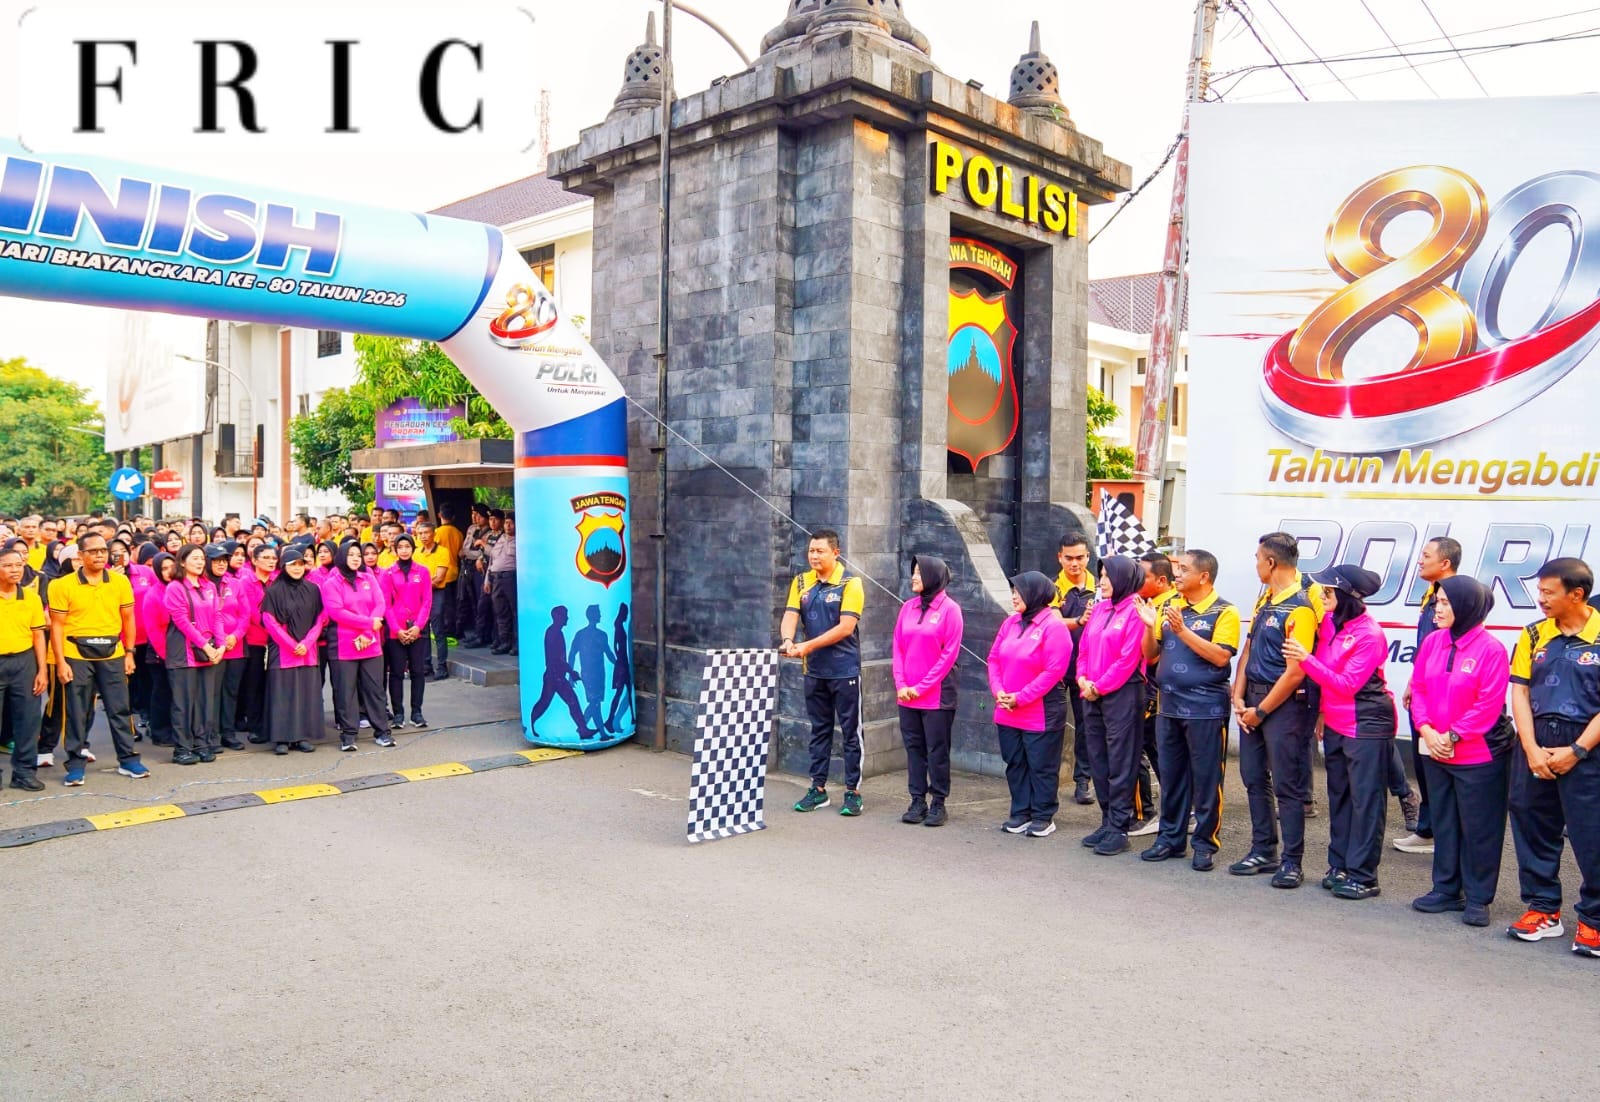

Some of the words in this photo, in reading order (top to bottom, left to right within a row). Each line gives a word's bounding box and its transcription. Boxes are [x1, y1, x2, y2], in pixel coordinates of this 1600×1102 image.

[931, 141, 1078, 238] POLISI
[51, 247, 223, 285] BHAYANGKARA
[226, 271, 257, 289] KE
[268, 277, 296, 295] 80
[298, 280, 362, 303] TAHUN
[361, 289, 408, 308] 2026
[970, 246, 1012, 281] TENGAH
[536, 361, 597, 383] POLRI
[547, 386, 569, 394] Untuk
[1267, 448, 1383, 484] Tahun
[1391, 448, 1600, 494] Mengabdi
[575, 497, 600, 510] JAWA
